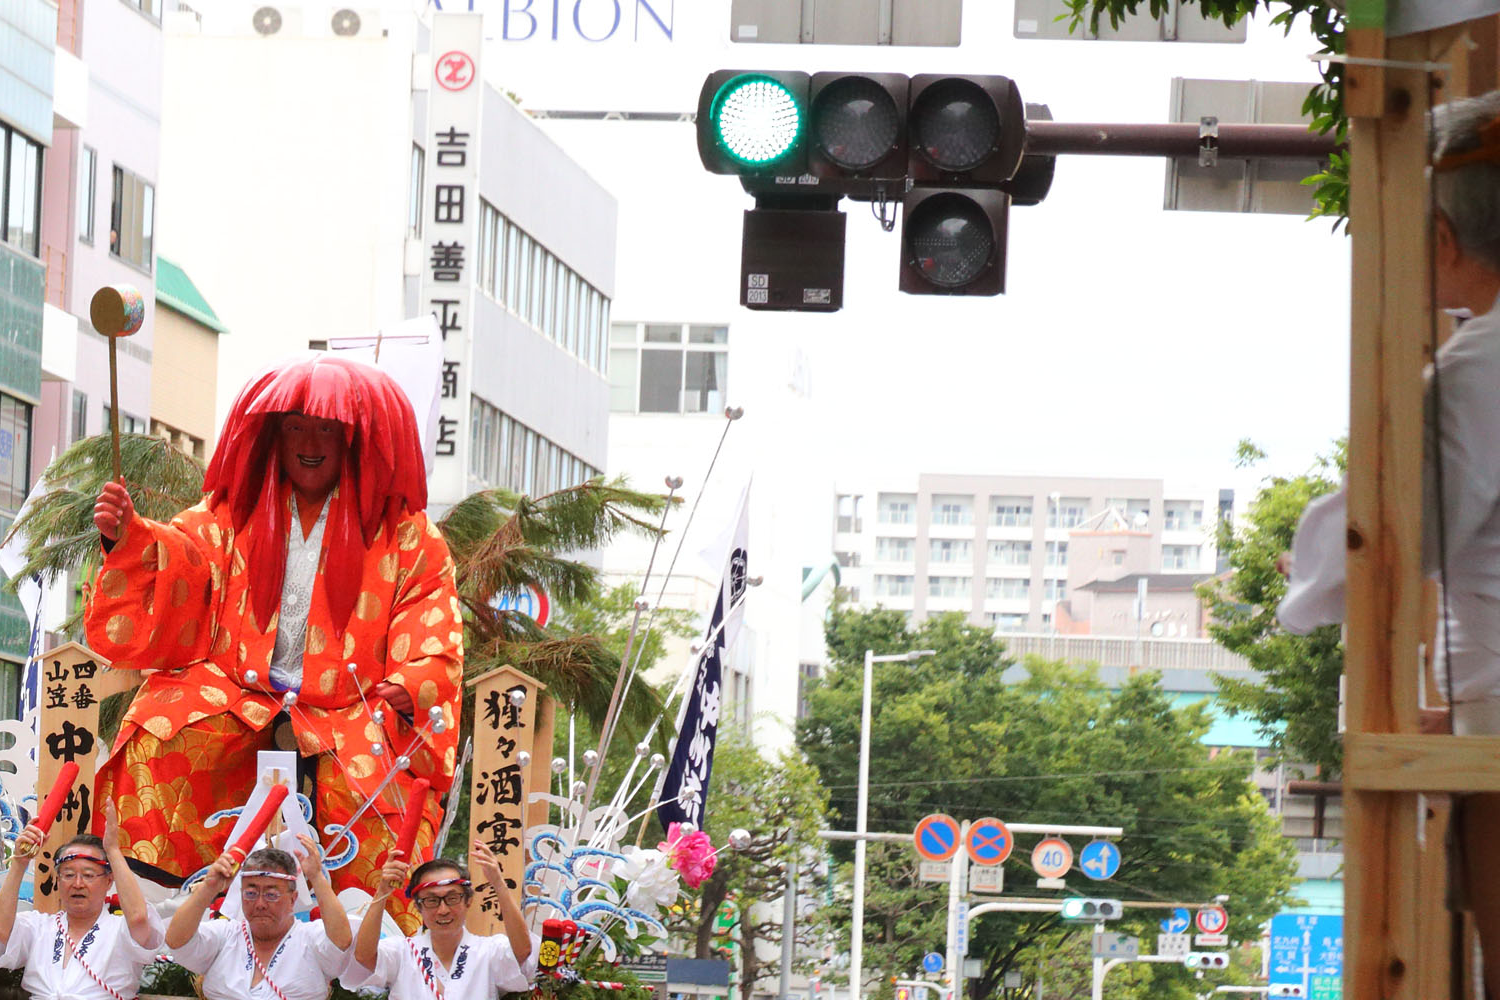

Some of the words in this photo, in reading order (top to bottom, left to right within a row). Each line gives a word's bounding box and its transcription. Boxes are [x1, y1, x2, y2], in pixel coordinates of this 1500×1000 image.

[426, 0, 674, 42] BION
[750, 289, 767, 301] 2013
[751, 276, 766, 287] SD
[46, 660, 70, 709] 山笠
[71, 660, 98, 709] 四番
[1041, 851, 1063, 868] 40
